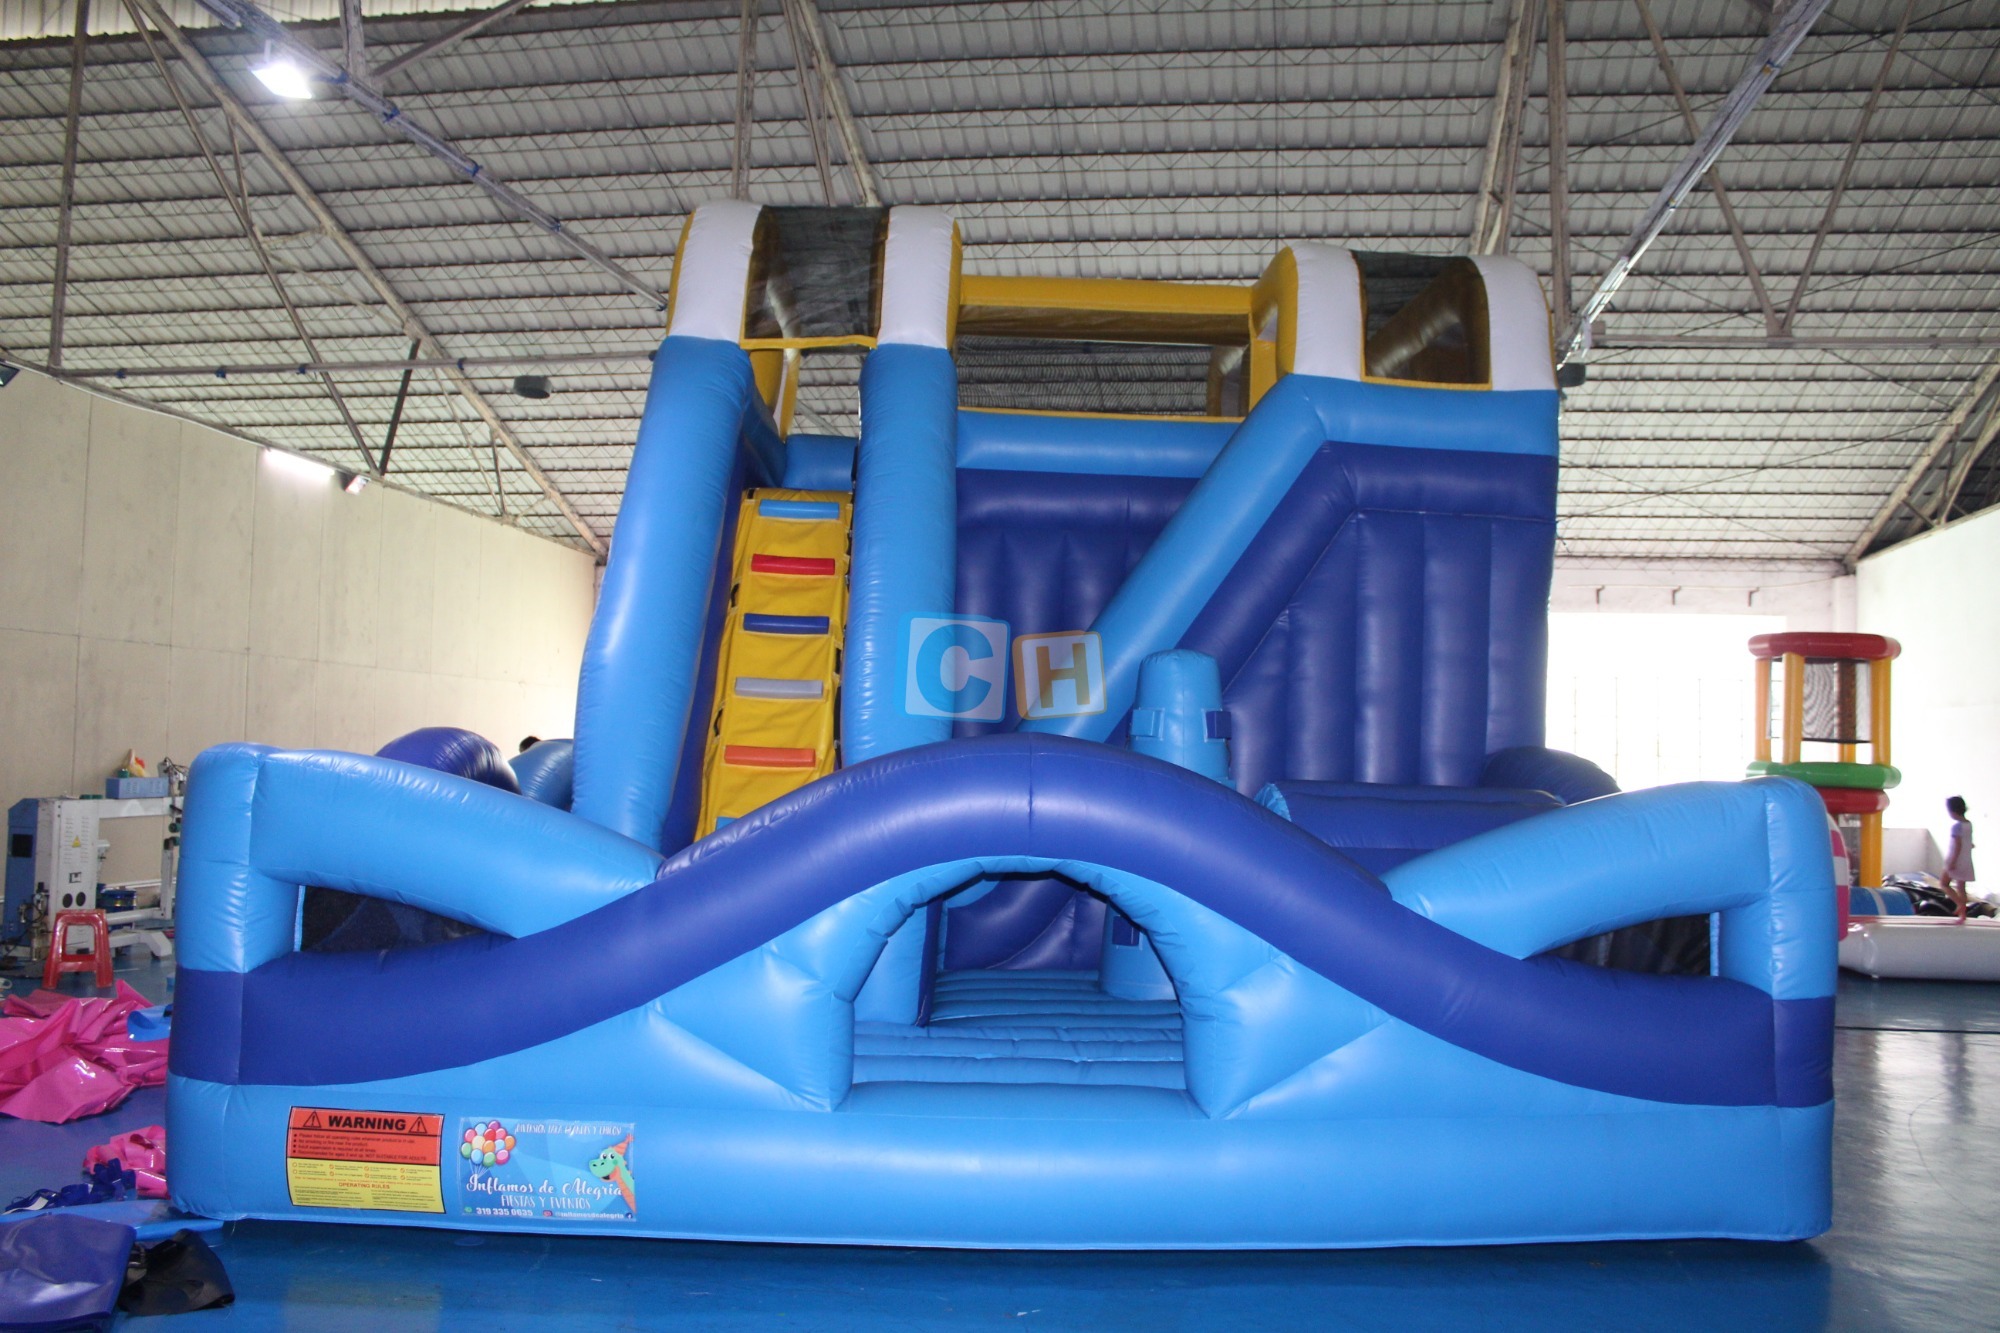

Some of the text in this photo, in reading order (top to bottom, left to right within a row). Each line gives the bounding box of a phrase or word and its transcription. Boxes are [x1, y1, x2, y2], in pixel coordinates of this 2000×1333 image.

[328, 1115, 406, 1131] WARNING
[466, 1174, 534, 1195] Inflamos
[539, 1180, 554, 1193] de
[501, 1195, 591, 1209] FIESTAS Y EVENTOS
[476, 1207, 491, 1215] 319
[492, 1208, 509, 1216] 335
